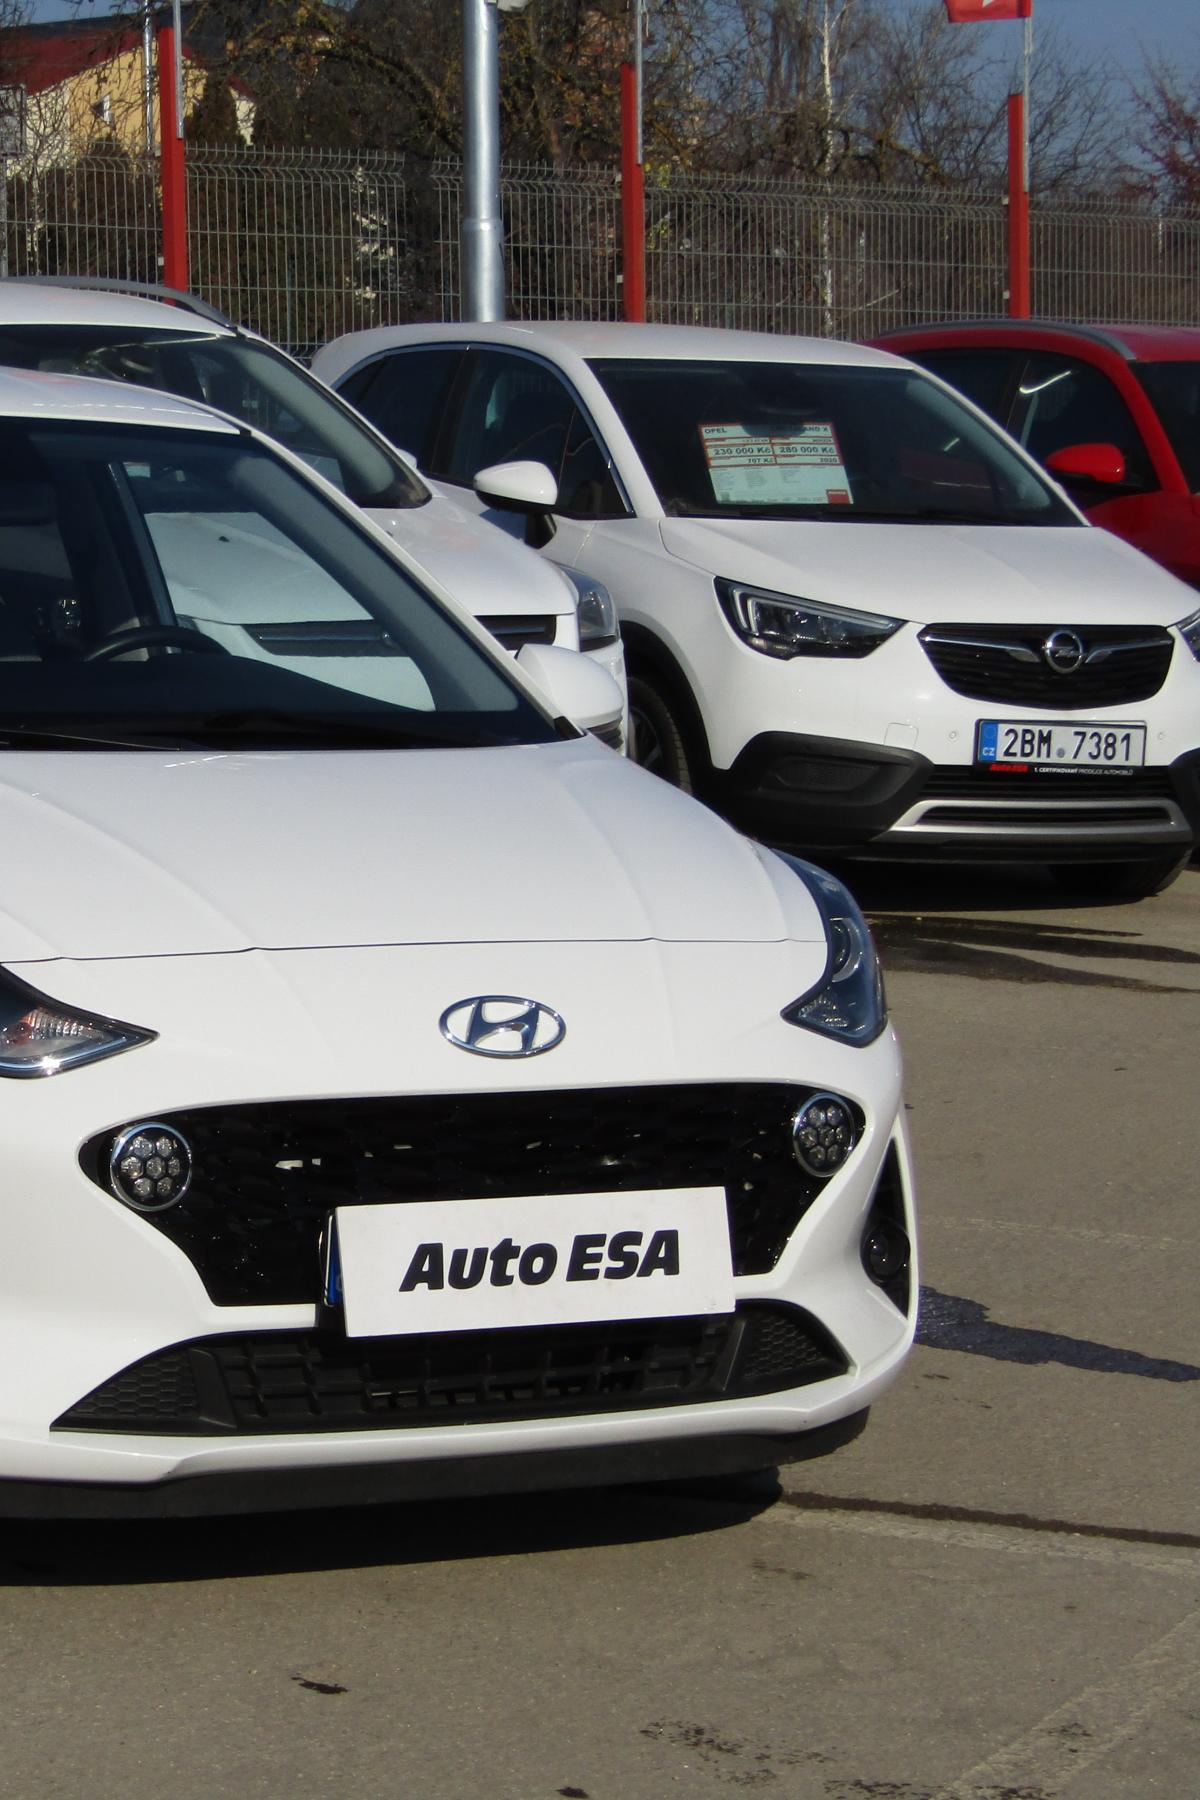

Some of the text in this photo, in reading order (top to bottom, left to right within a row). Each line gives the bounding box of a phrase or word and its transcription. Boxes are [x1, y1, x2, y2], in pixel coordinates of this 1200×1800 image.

[714, 448, 732, 456] 230
[735, 447, 754, 455] 000
[800, 446, 818, 454] 000
[1003, 728, 1132, 761] 2BM 7381
[982, 747, 995, 756] CZ
[399, 1229, 680, 1292] Auto ESA
